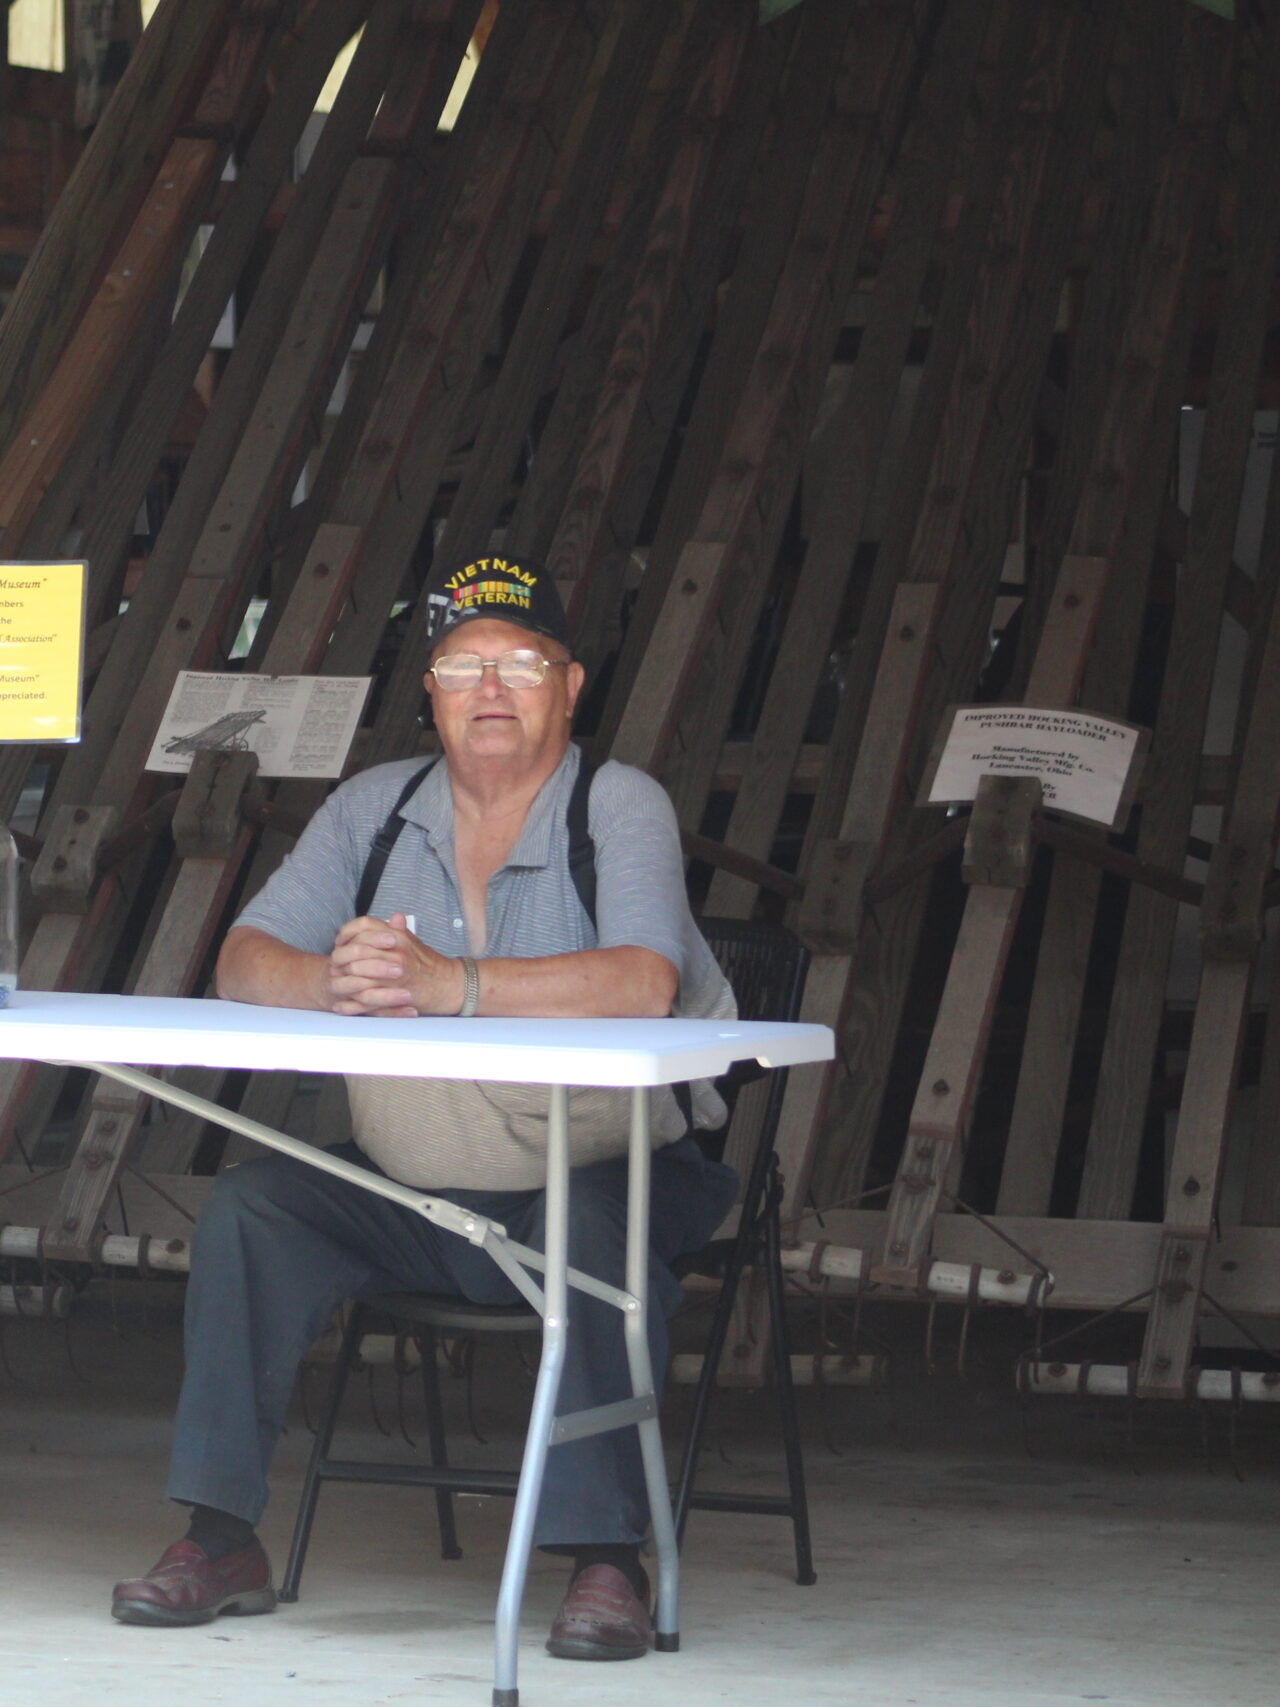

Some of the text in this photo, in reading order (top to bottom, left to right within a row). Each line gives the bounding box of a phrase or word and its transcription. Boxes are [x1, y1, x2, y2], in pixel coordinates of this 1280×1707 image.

[444, 558, 538, 590] VIETNAM
[454, 592, 531, 609] VETERAN
[964, 713, 1126, 739] IMPROVED HOCKING VALLEY
[980, 721, 1107, 742] PUSHBAR HAYLOADER
[971, 753, 1016, 763] Hocking
[1018, 754, 1050, 766] Valley
[992, 745, 1080, 762] Manufactured by
[1046, 766, 1073, 776] Ohio
[1043, 782, 1057, 792] By
